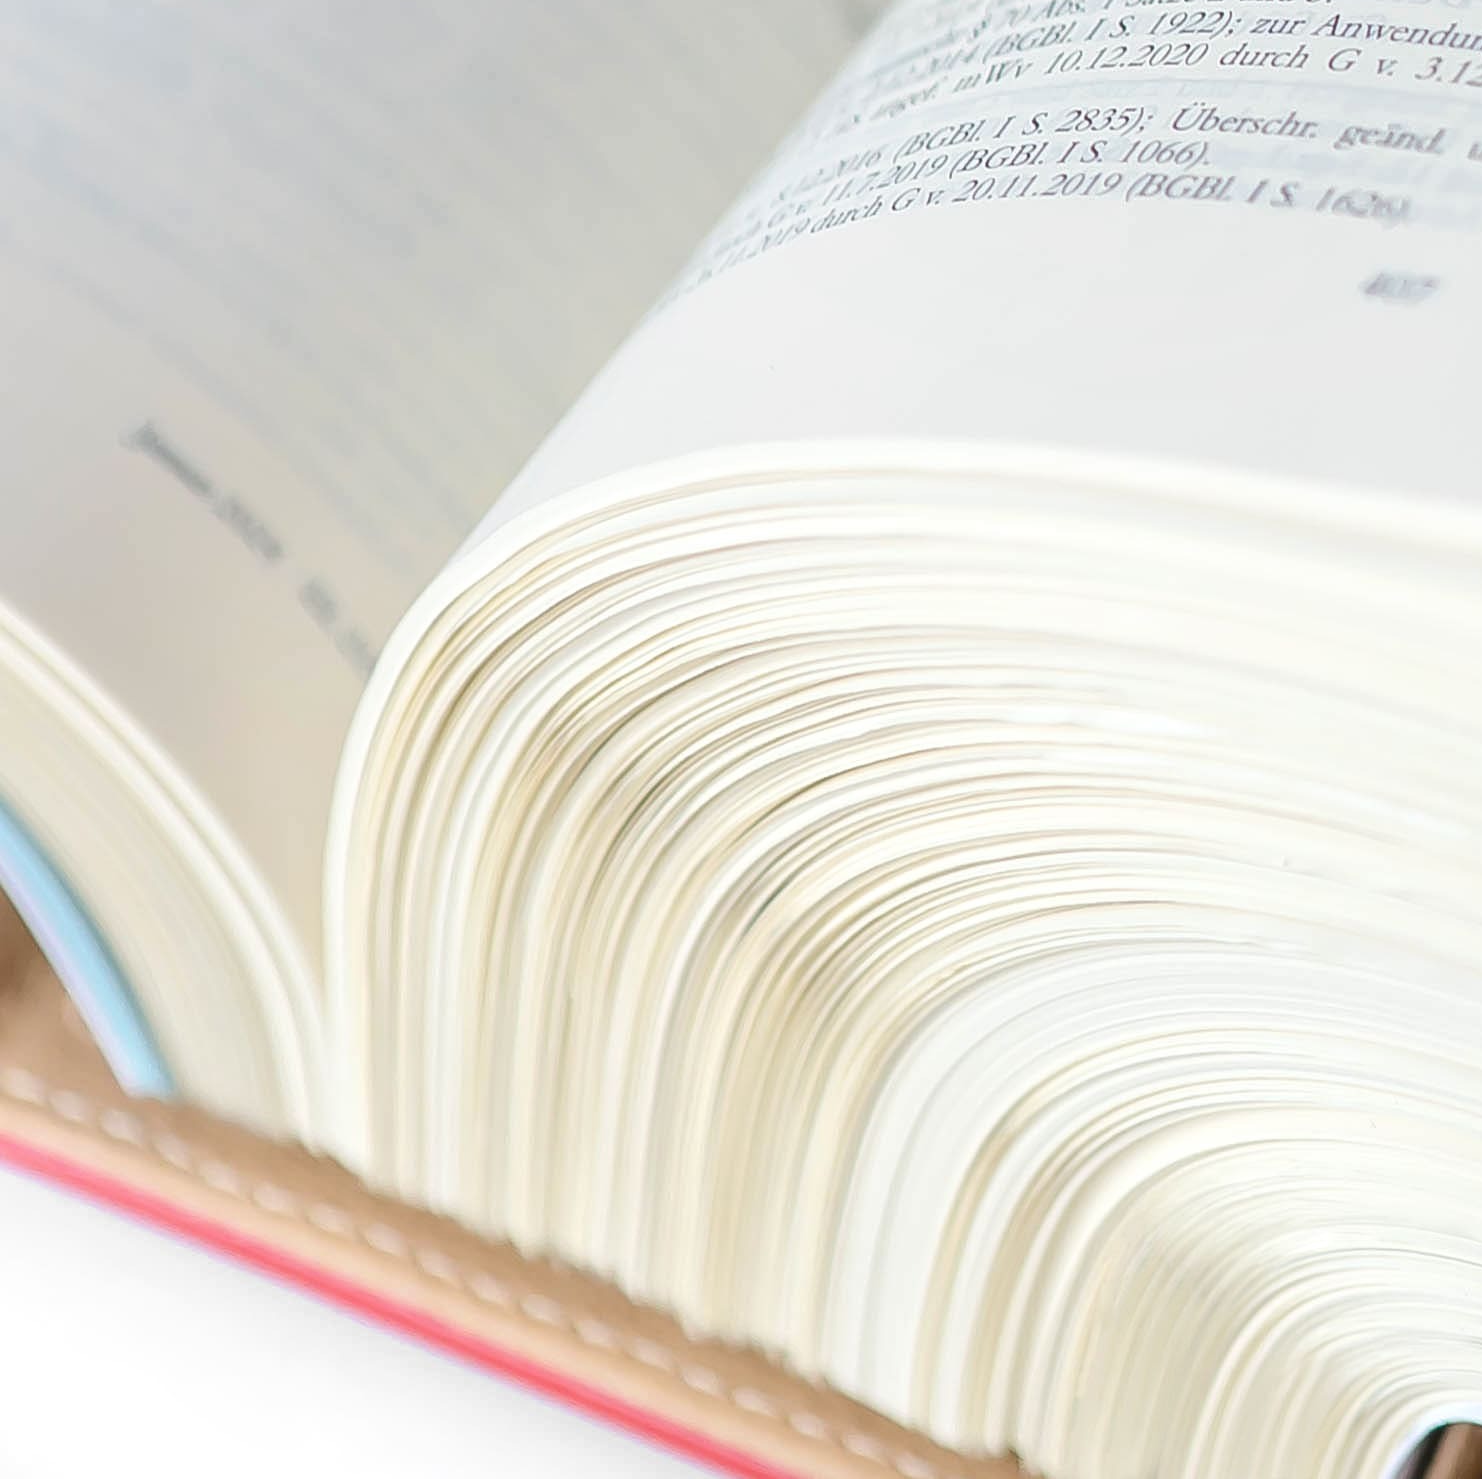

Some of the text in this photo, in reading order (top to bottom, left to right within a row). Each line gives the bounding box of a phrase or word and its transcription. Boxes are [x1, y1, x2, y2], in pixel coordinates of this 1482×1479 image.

[1109, 16, 1134, 39] S.
[1146, 10, 1240, 40] 1922);
[1249, 14, 1306, 37] zur
[1043, 42, 1210, 76] 10.12.2020
[1219, 46, 1310, 70] durch
[1327, 47, 1364, 74] G
[892, 118, 986, 162] (BGBl.
[1019, 112, 1047, 138] S.
[1055, 105, 1154, 135] 2835);
[1170, 102, 1318, 139] Überschr.
[948, 142, 1045, 180] (BGBl.
[1078, 140, 1105, 165] S.
[1118, 139, 1211, 167] 1066).
[951, 172, 1121, 203] 20.11.2019
